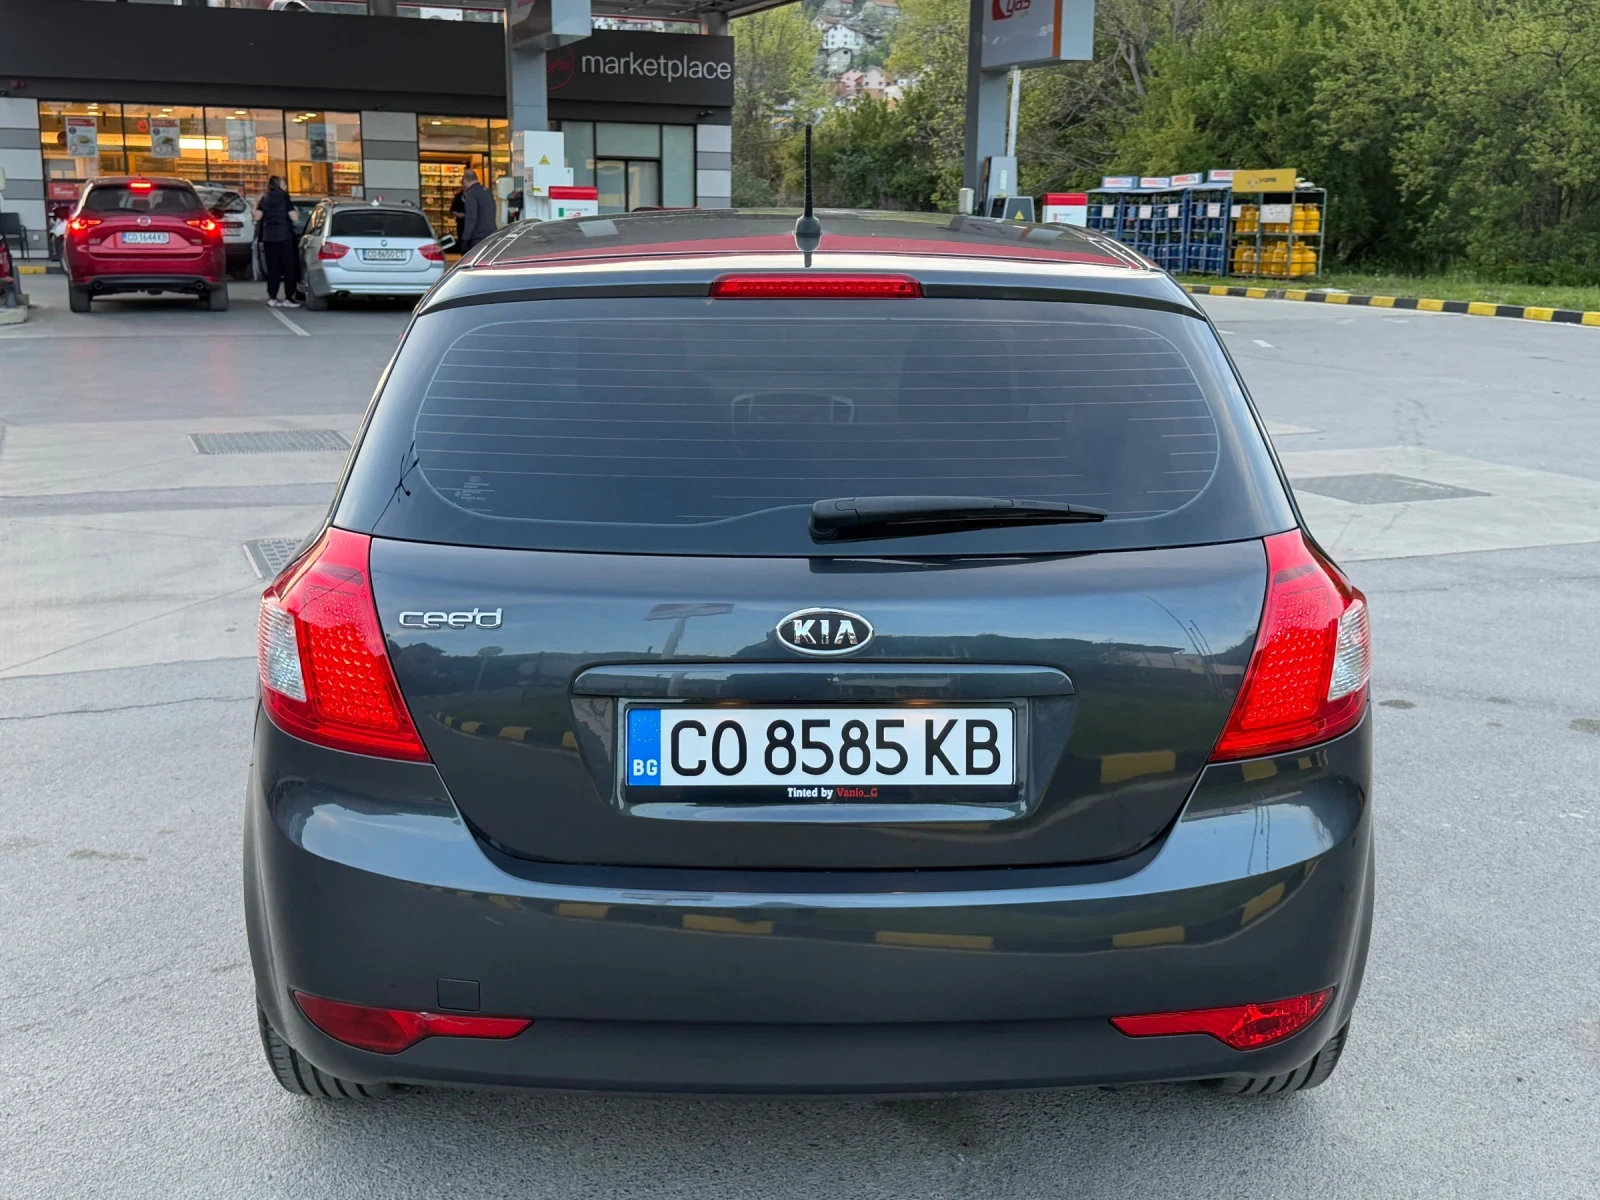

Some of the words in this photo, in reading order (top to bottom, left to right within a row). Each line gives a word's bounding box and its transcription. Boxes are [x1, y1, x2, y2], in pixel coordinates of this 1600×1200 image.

[581, 52, 731, 82] marketplace
[793, 619, 858, 645] KIA
[670, 719, 748, 777] CO
[764, 719, 909, 776] 8585
[925, 719, 1001, 776] KB
[633, 759, 658, 776] BG
[787, 787, 818, 798] Tinted
[820, 787, 834, 799] by
